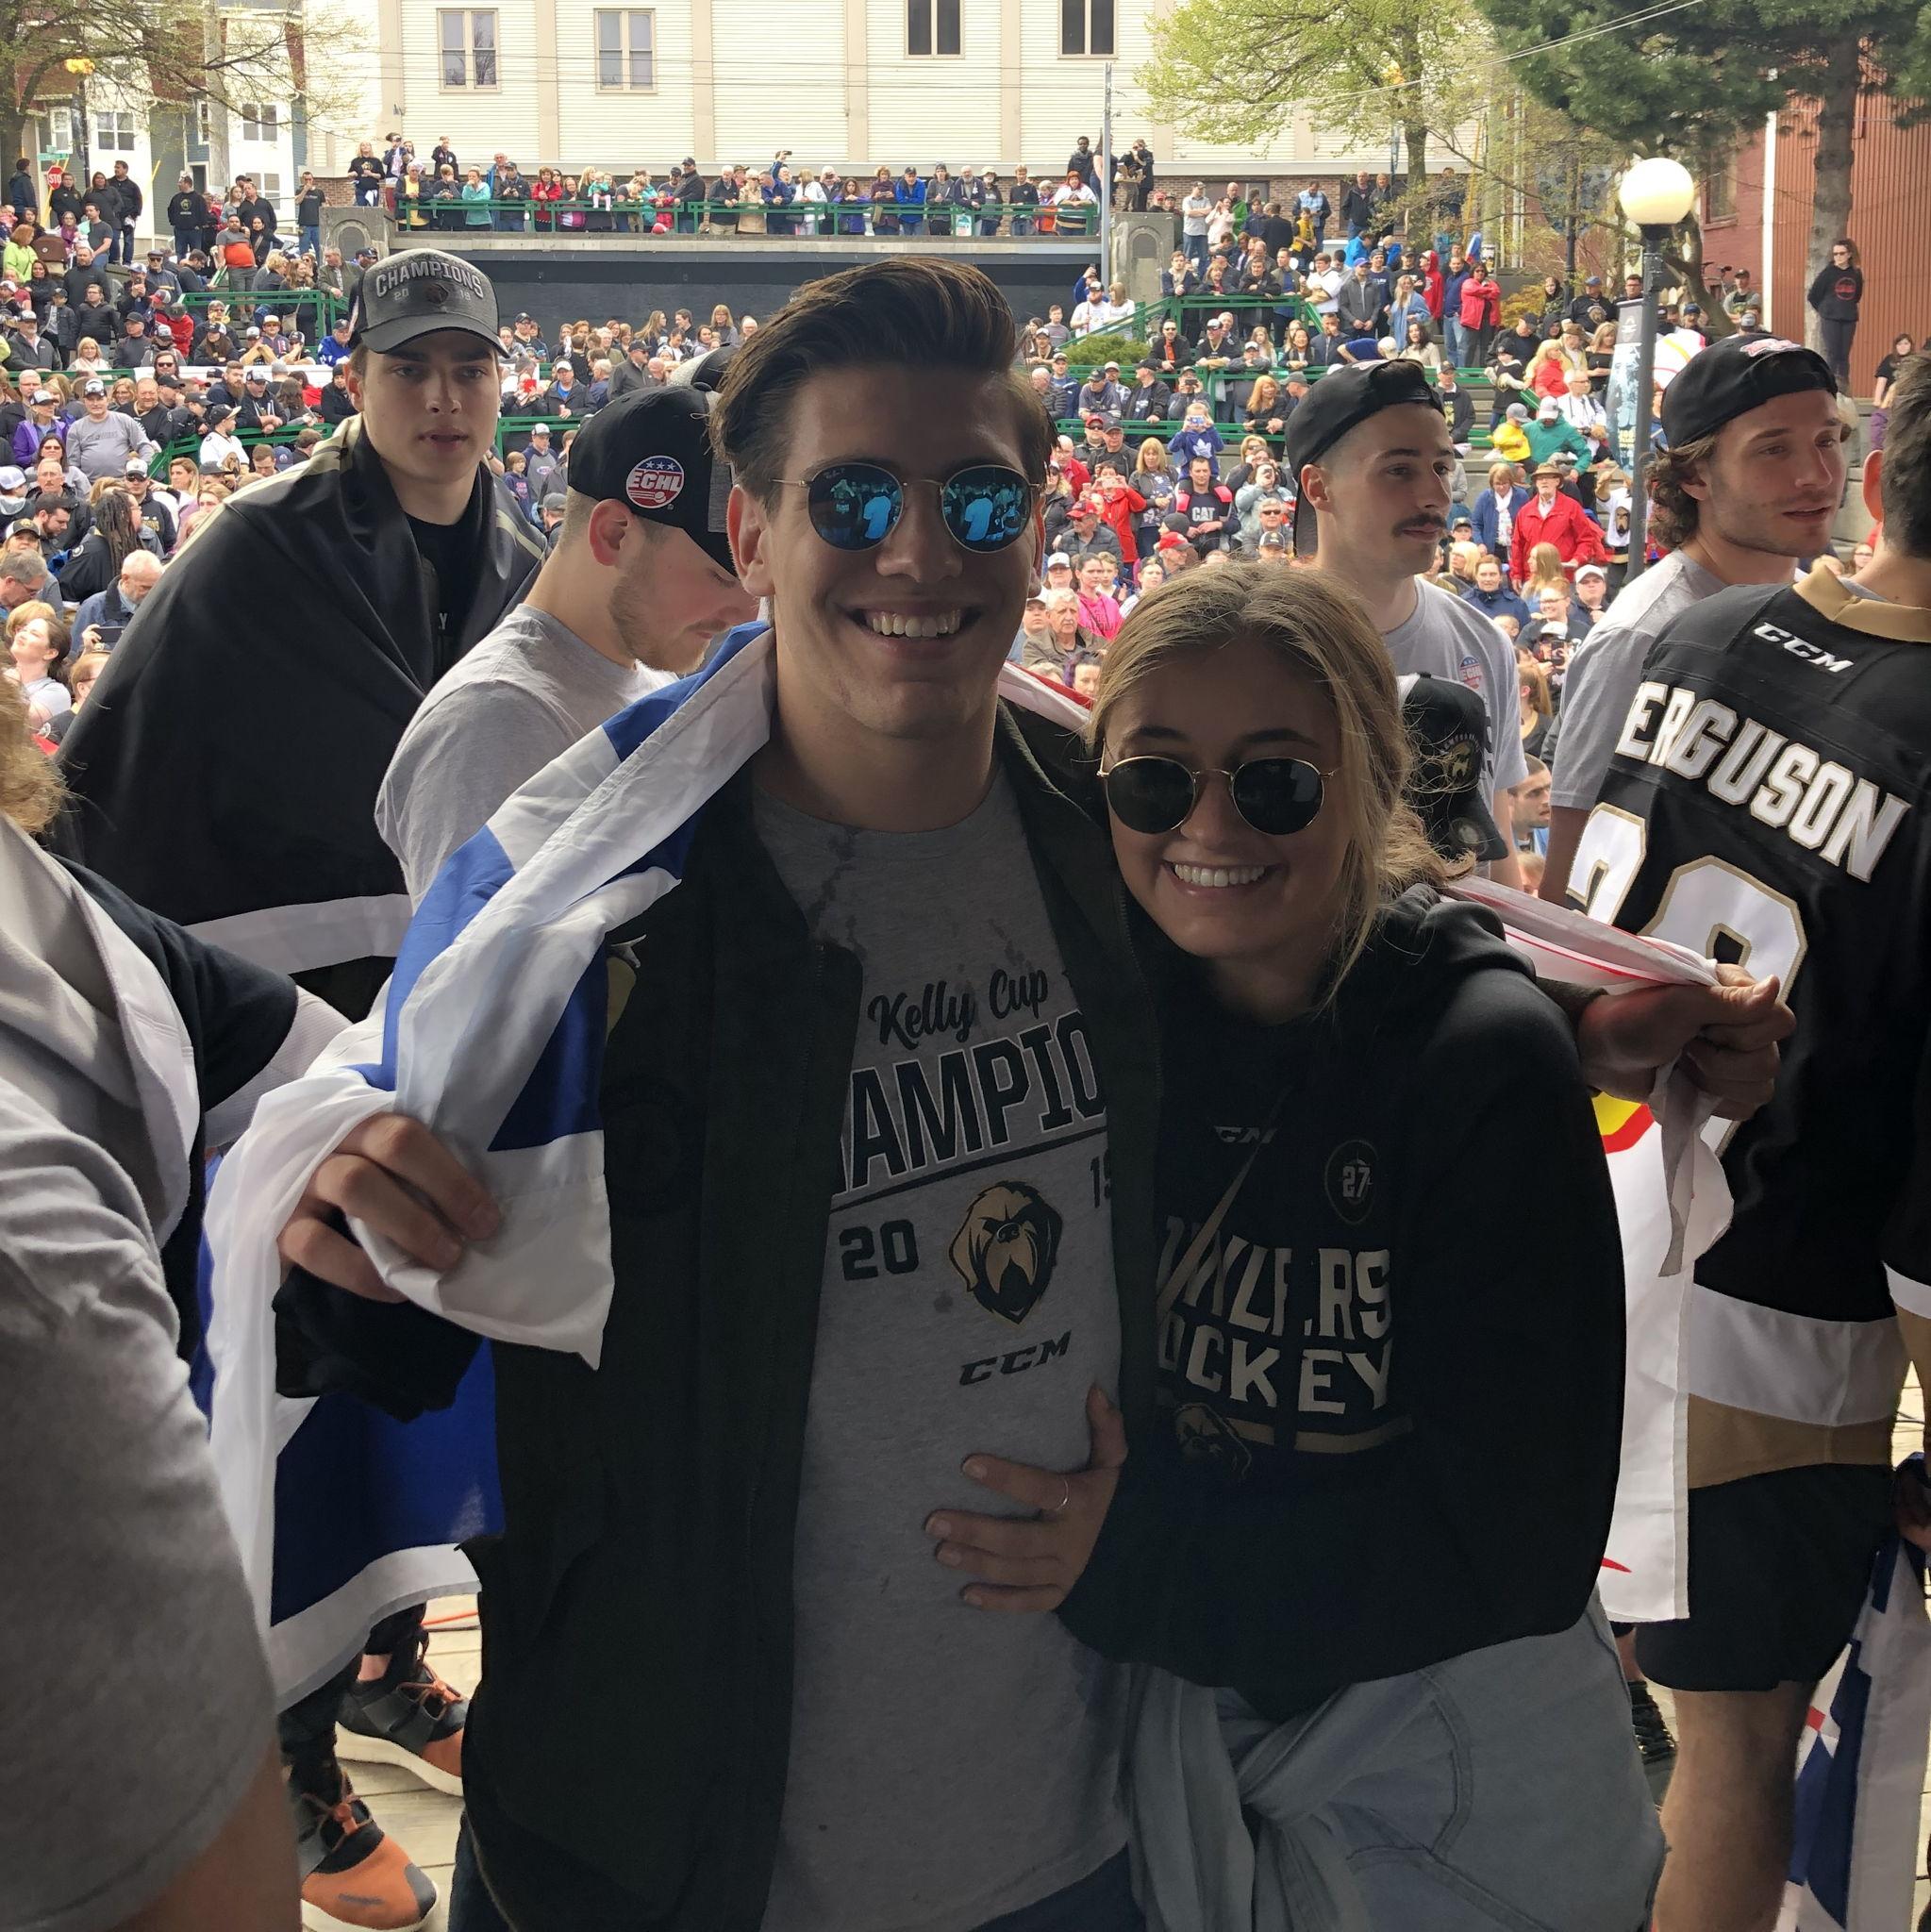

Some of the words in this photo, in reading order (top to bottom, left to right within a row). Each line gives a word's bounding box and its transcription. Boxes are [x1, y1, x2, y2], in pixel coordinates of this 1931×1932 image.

[49, 174, 62, 184] STO
[376, 260, 484, 299] CHAMPIONS
[393, 288, 409, 300] 20
[628, 470, 682, 491] ECHL
[1191, 506, 1215, 522] CAT
[1753, 621, 1854, 673] CCM
[1615, 680, 1912, 883] ERGUSON
[867, 980, 974, 1051] Kelly
[990, 969, 1049, 1020] Cup
[831, 1008, 1107, 1199] AMPIO
[1342, 1165, 1371, 1198] 27
[839, 1218, 920, 1281] 20
[958, 1329, 1073, 1387] CCM
[1158, 1312, 1394, 1415] OCKEY
